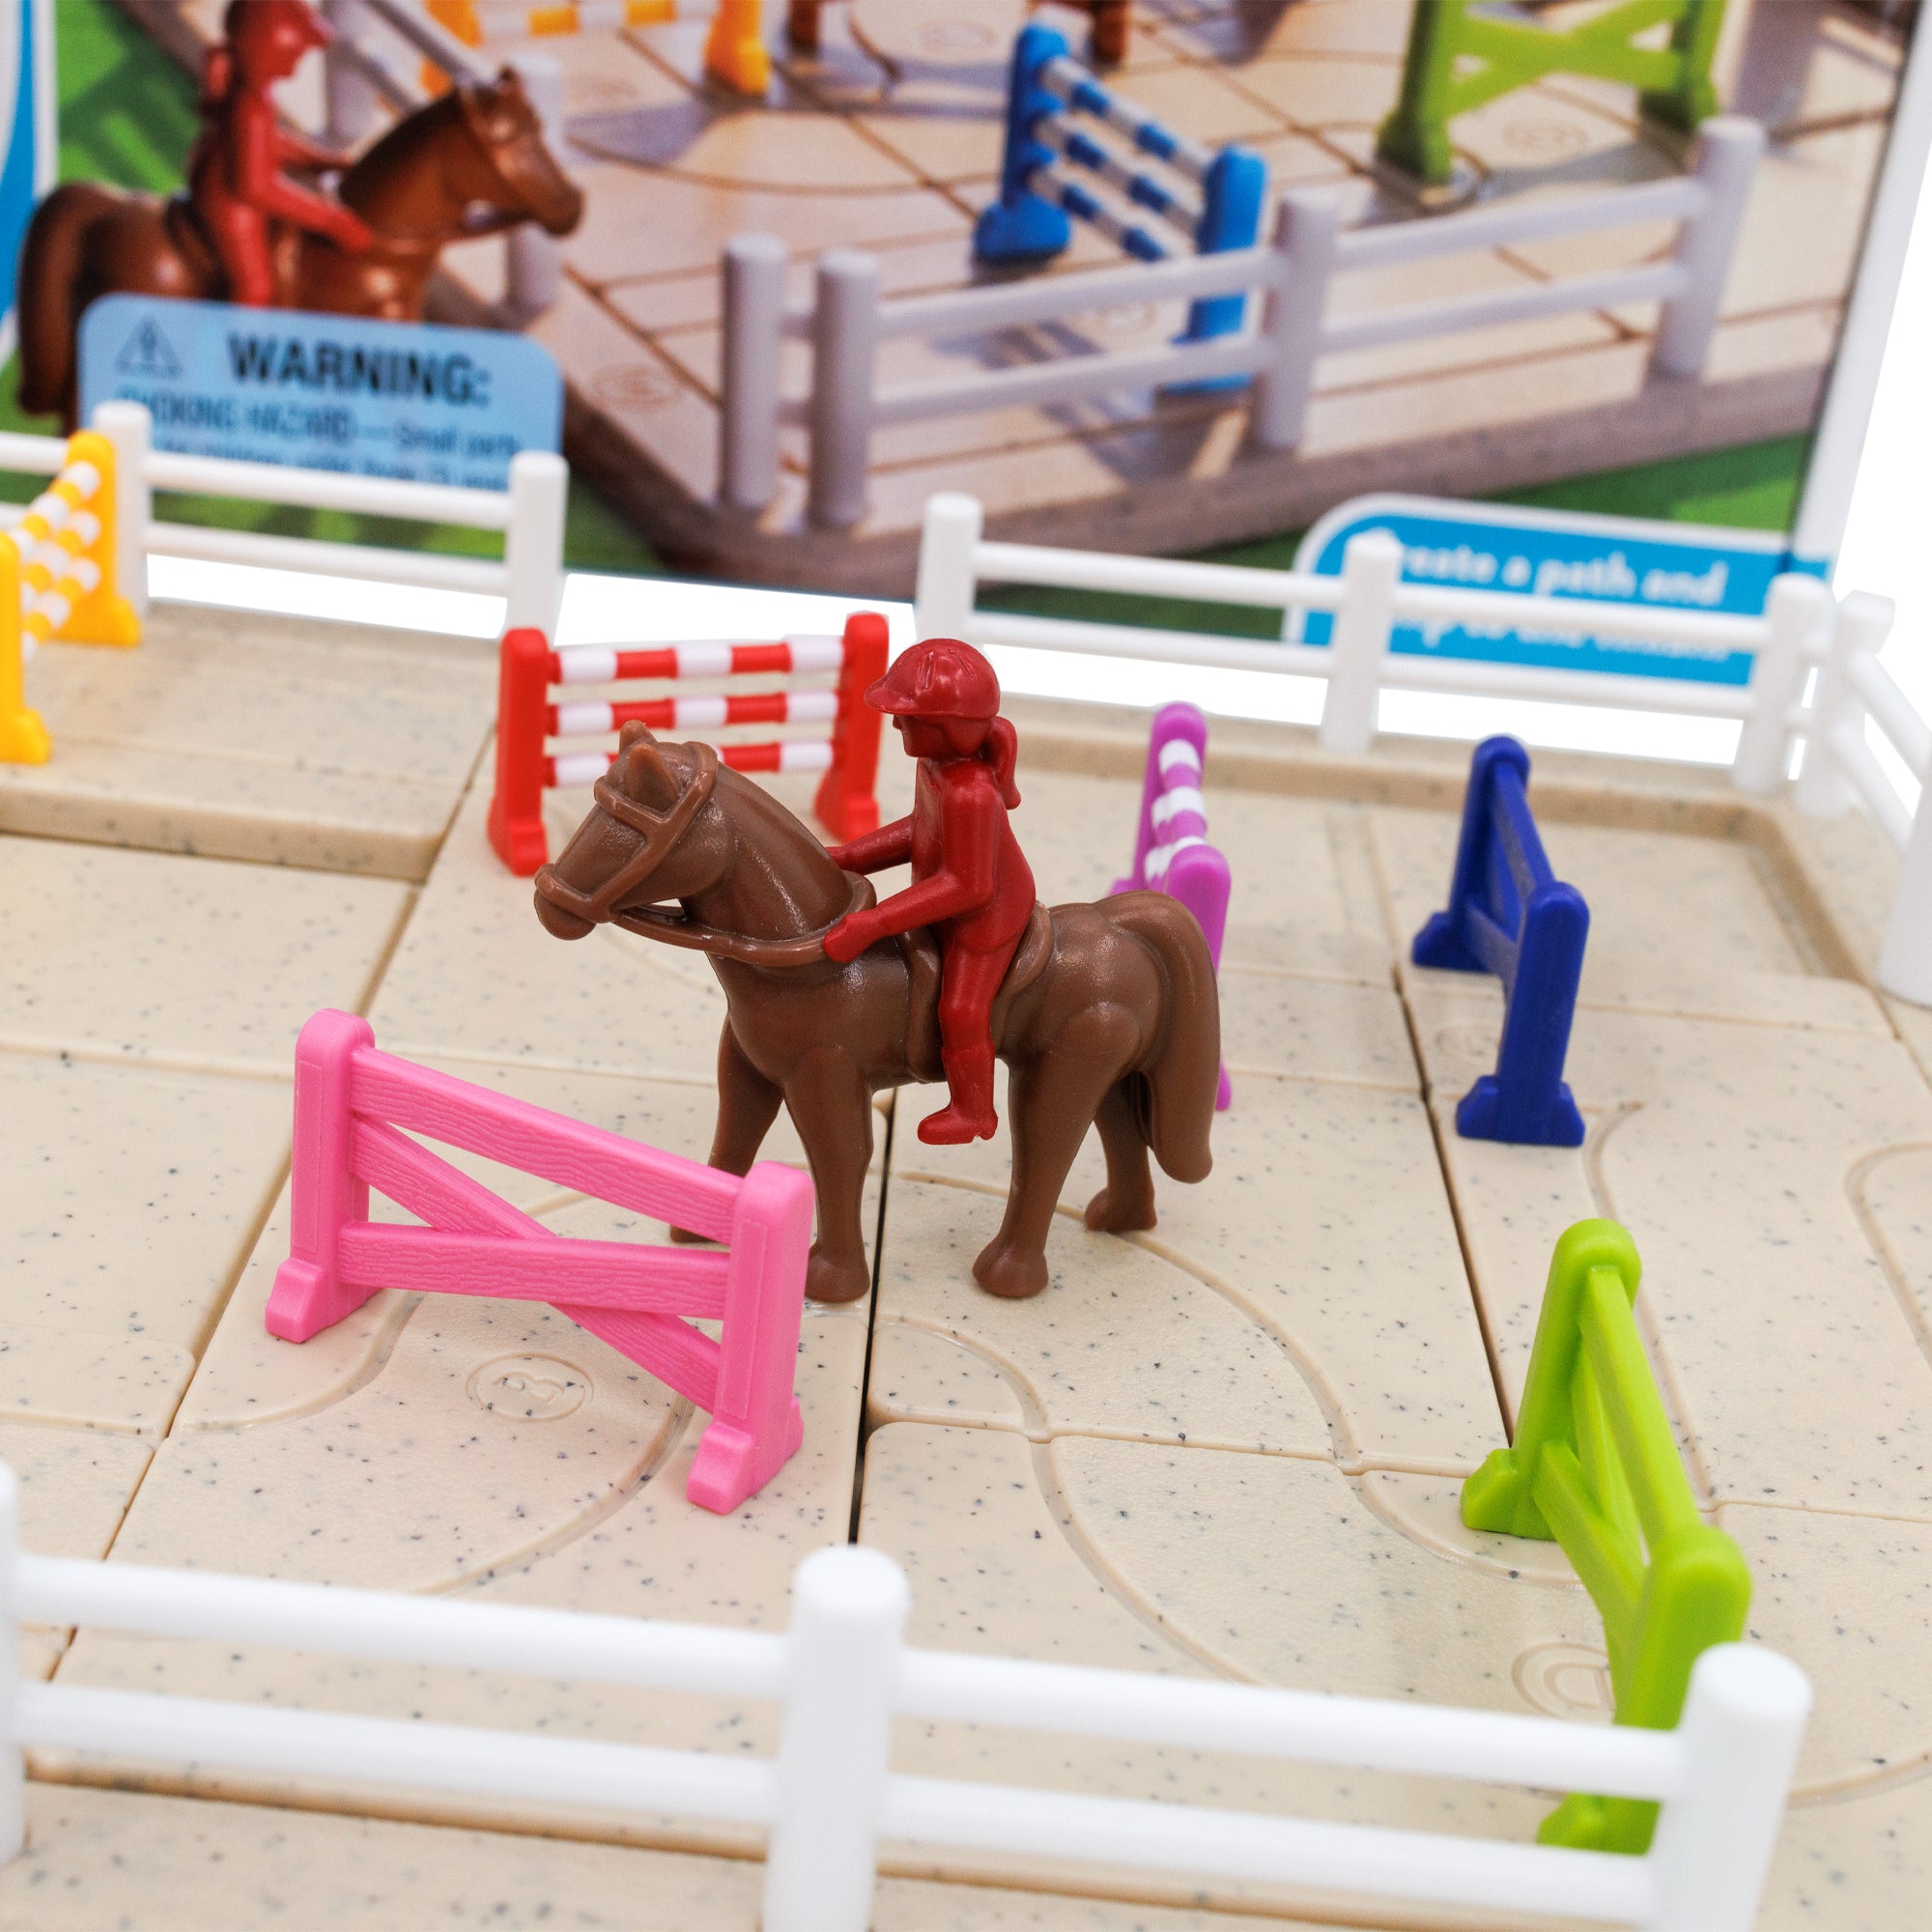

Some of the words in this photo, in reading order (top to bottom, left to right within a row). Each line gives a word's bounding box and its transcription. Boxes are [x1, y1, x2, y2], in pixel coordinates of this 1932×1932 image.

[228, 331, 492, 407] WARNING:
[1501, 554, 1531, 587] a
[1533, 550, 1636, 599] path
[1641, 558, 1729, 608] and
